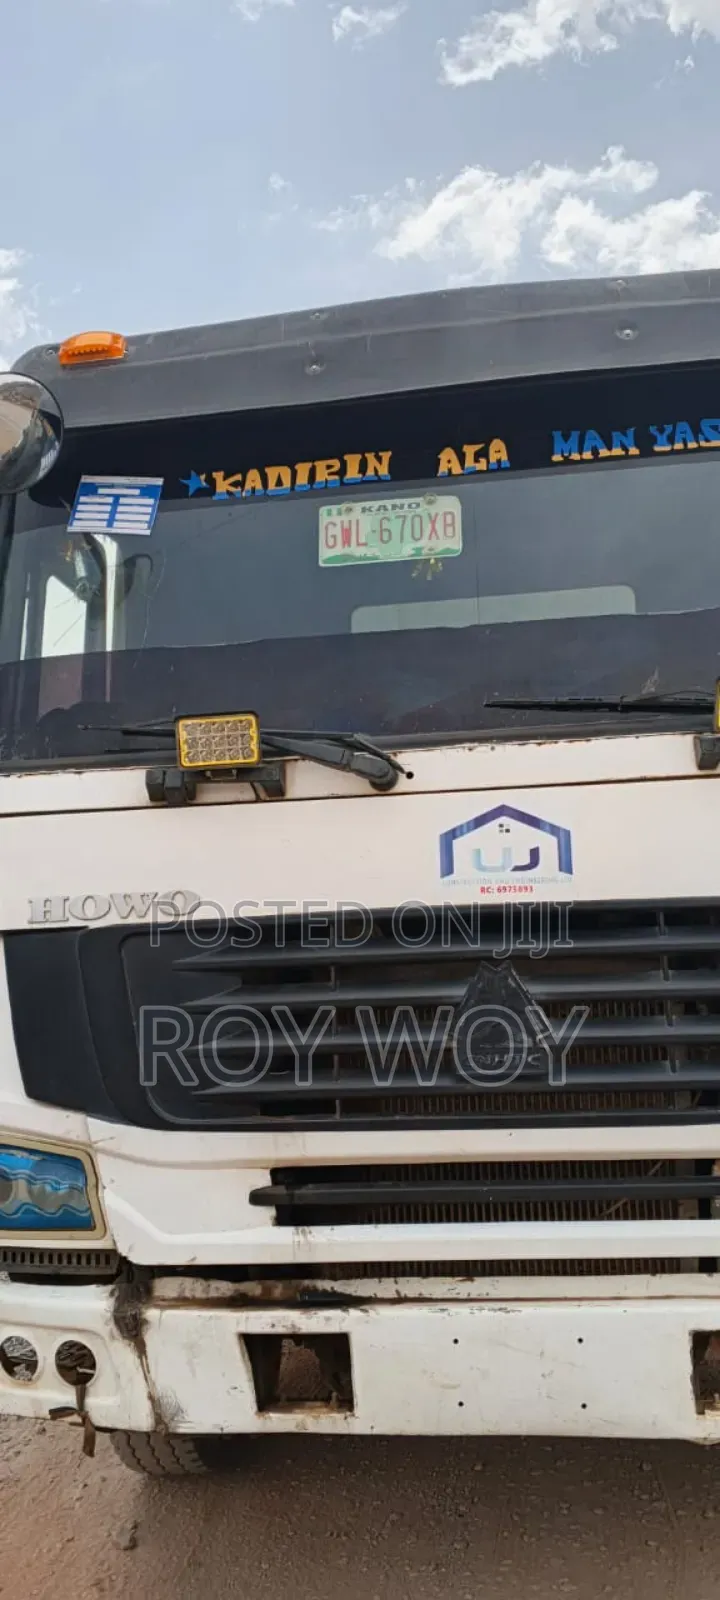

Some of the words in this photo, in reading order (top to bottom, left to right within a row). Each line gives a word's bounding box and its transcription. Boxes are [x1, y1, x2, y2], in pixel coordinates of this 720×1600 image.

[212, 451, 392, 500] KADIRIN
[551, 427, 640, 461] MAN
[361, 502, 421, 513] KANO
[27, 890, 201, 924] HOWO
